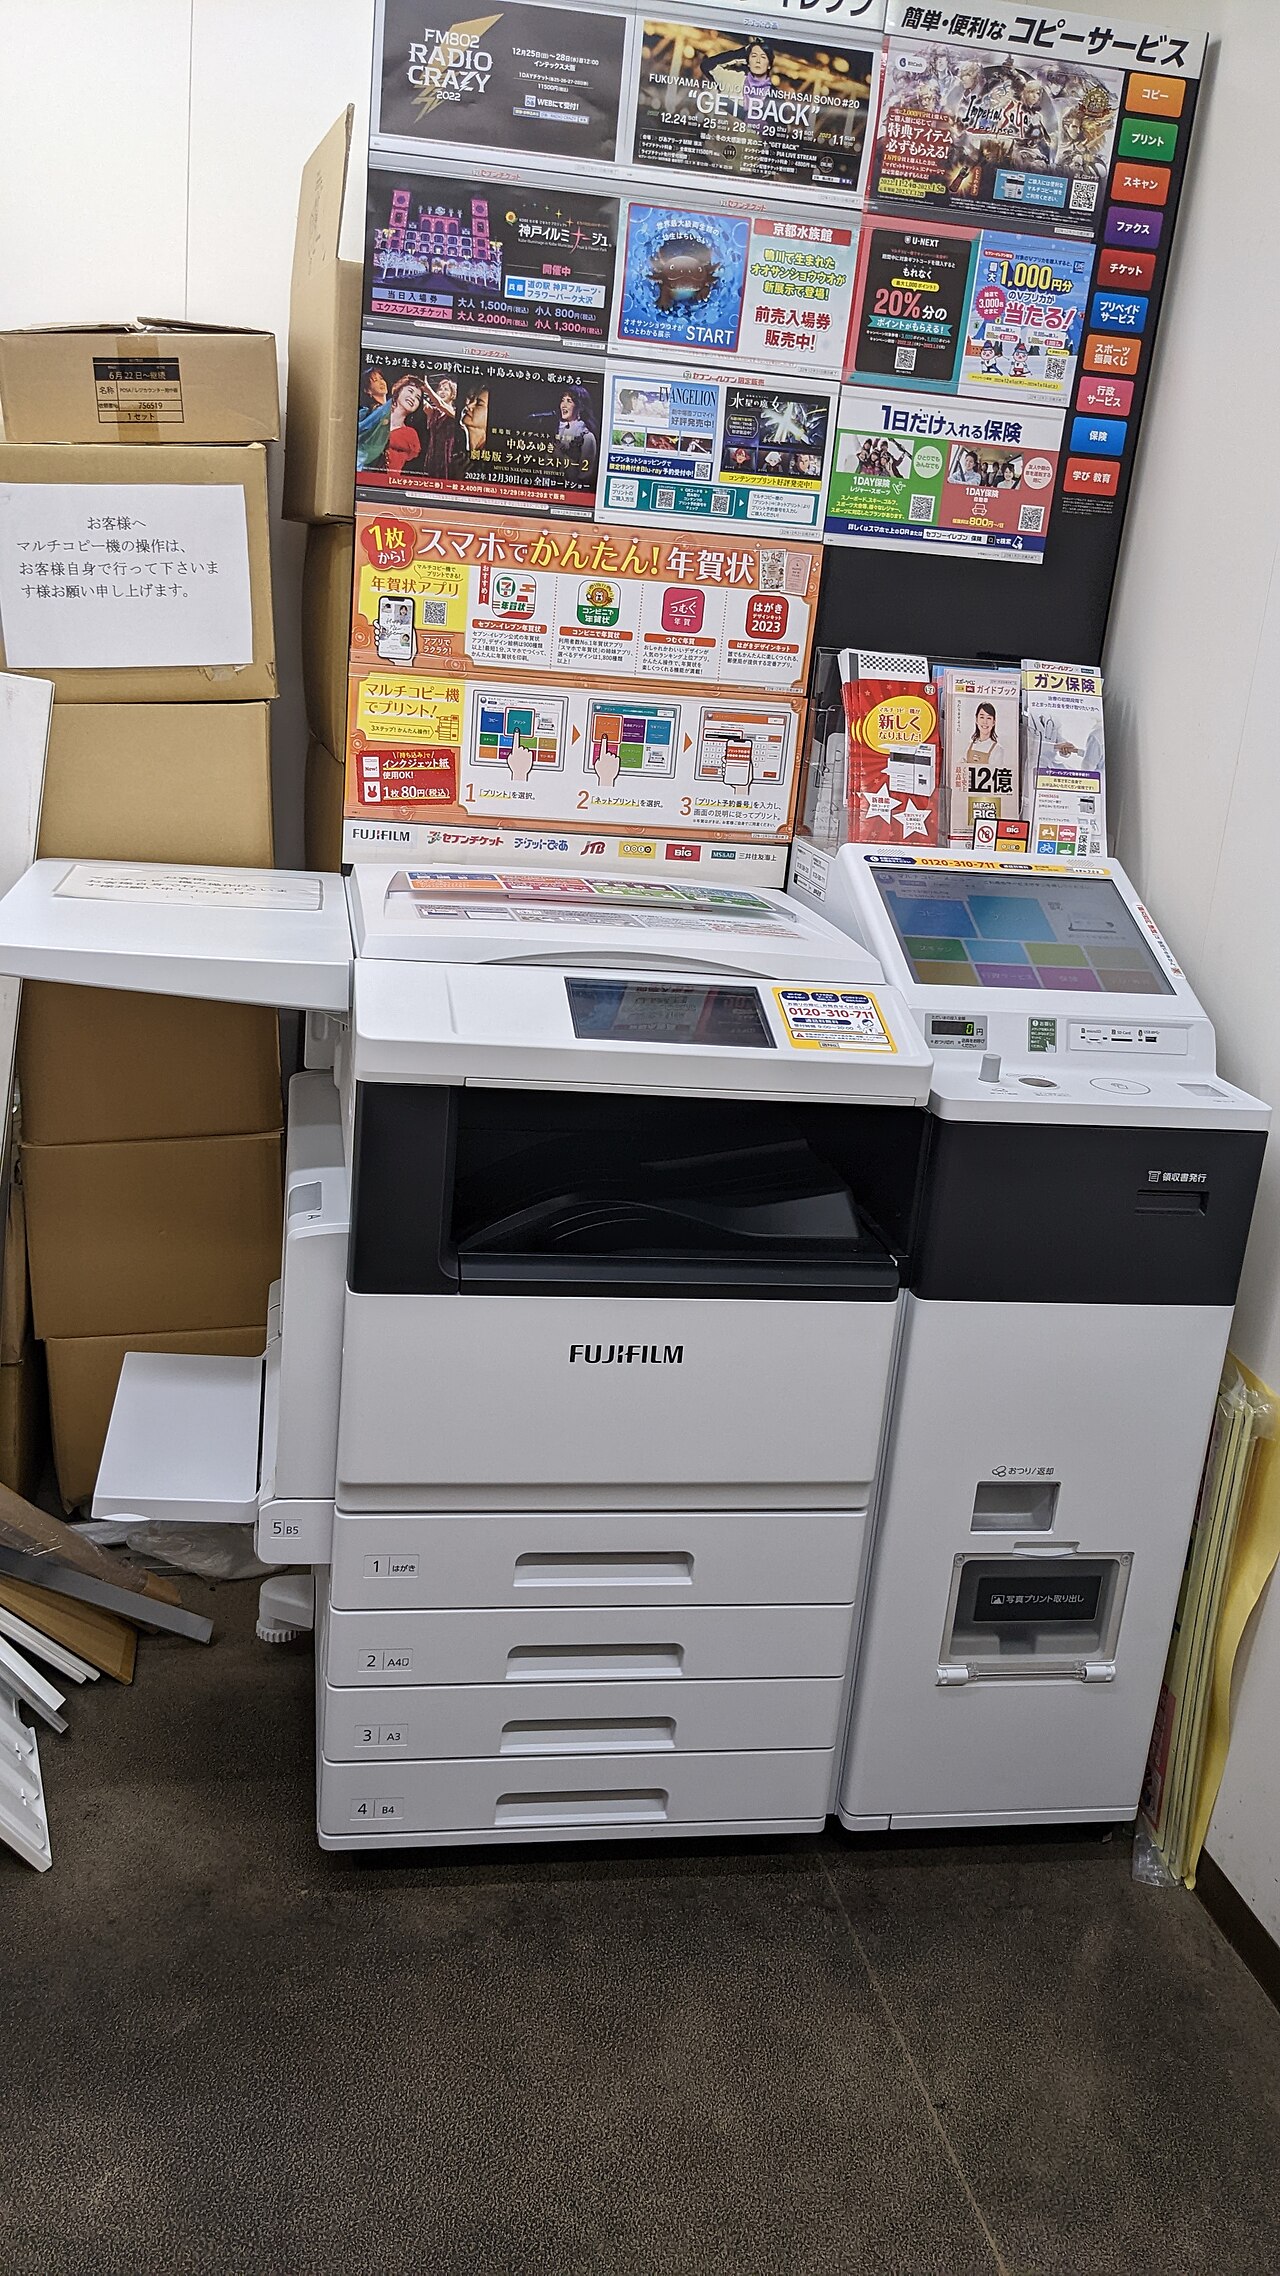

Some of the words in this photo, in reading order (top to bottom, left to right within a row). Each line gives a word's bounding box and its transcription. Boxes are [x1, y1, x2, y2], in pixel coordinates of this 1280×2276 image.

[425, 28, 479, 48] FM802
[1008, 15, 1191, 67] コピーサービス
[409, 43, 493, 72] RADIO
[407, 66, 491, 93] CRAZY
[437, 91, 461, 101] 2022
[650, 73, 699, 88] FUKUYAMA
[702, 78, 726, 91] FUYU
[729, 81, 741, 92] NO
[744, 85, 812, 102] DAIKANSHASAI
[814, 95, 841, 107] SONO
[842, 98, 860, 109] #20
[1142, 89, 1168, 100] コピー
[661, 112, 686, 125] 12.24
[703, 118, 716, 128] 25
[733, 122, 746, 132] 28
[762, 126, 775, 136] 29
[792, 130, 802, 140] 31
[833, 136, 843, 145] 1.1
[888, 123, 953, 143] 特典アイテム
[1132, 134, 1164, 146] プリント
[1124, 177, 1158, 189] スキャン
[773, 223, 832, 242] 京都水族館
[1116, 222, 1150, 234] ファクス
[518, 223, 608, 249] 神戸イルミナージュ
[764, 250, 836, 270] 鴨川で生まれた
[751, 264, 846, 285] オオサンショウウオが
[903, 268, 932, 279] もれなく
[988, 262, 998, 283] 最大
[1000, 260, 1074, 292] 1,000円分
[1110, 263, 1142, 276] チケット
[527, 280, 550, 290] 道の駅
[528, 291, 593, 304] フラワーパーク大沢
[874, 288, 947, 320] 20%分の
[1008, 291, 1055, 304] のVプリカが
[458, 298, 475, 309] 大人
[536, 307, 551, 316] 小人
[1100, 302, 1140, 315] プリペイド
[376, 303, 448, 318] エクスプレスチケット
[457, 311, 475, 321] 大人
[535, 320, 551, 330] 小人
[754, 306, 831, 330] 前売入場券
[1004, 301, 1076, 331] 当たる!
[1101, 312, 1135, 325] サービス
[624, 318, 684, 331] オオサンショウウオが
[877, 319, 944, 334] ポイントがもらえる!
[624, 328, 671, 339] もっとわかる展示
[685, 326, 734, 345] START
[765, 329, 816, 350] 販売中!
[1096, 344, 1131, 355] スポーツ
[99, 386, 114, 394] 名称
[659, 386, 716, 407] EVANGELION
[1097, 385, 1115, 396] 行政
[728, 392, 780, 412] 水星の魔女
[1087, 394, 1121, 407] サービス
[881, 404, 1023, 444] 1日だけ入れる保険
[1090, 430, 1107, 442] 保険
[507, 439, 555, 453] 中島みゆき
[470, 451, 502, 463] 劇場版
[610, 456, 671, 467] セブンネットショッピングで
[917, 454, 940, 463] ひとりでも
[916, 461, 939, 470] みんなでも
[465, 472, 486, 482] 2022年
[534, 477, 590, 489] 全国ロードショー
[1073, 471, 1090, 481] 学び
[1093, 473, 1111, 483] 教育
[88, 516, 146, 530] お客様へ
[368, 524, 407, 551] 1枚
[17, 539, 186, 553] マルチコピー機の操作は、
[378, 550, 405, 563] から!
[19, 562, 219, 576] お客様自身で行って下さいま
[416, 564, 456, 573] マルチコピー機で
[21, 584, 192, 598] す様お願い申し上げます。
[371, 576, 459, 596] 年賀状アプリ
[501, 601, 526, 611] 年賀状
[583, 608, 614, 616] コンビニで
[670, 601, 697, 614] つむぐ
[753, 601, 783, 613] はがき
[585, 615, 610, 624] 年賀状
[674, 618, 690, 626] 年賀
[752, 613, 781, 621] デザインキット
[751, 620, 781, 632] 2023
[573, 630, 620, 639] コンビニで年賀状
[665, 636, 695, 645] つむぐ年賀
[423, 638, 450, 647] アプリで
[737, 642, 790, 652] はがきデザインキット
[1035, 674, 1096, 693] ガン保険
[365, 683, 459, 703] マルチコピー機
[977, 686, 1017, 695] ガイドブック
[365, 701, 438, 718] でプリント!
[879, 714, 921, 731] 新しく
[383, 757, 450, 769] インクジェット紙
[383, 771, 413, 779] 使用OK!
[969, 767, 1012, 793] 12億
[384, 786, 399, 797] 1枚
[465, 783, 476, 802] 1
[479, 788, 535, 800] 「プリント」を選択。
[576, 790, 589, 810] 2
[591, 796, 664, 809] 「ネットプリント」を選択。
[680, 797, 691, 816] 3
[353, 828, 410, 842] FUJIFILM
[443, 834, 504, 846] セブンチケット
[580, 841, 606, 856] JTB
[921, 858, 995, 869] 0120-310-711
[789, 1008, 874, 1019] 0120-310-711
[966, 1024, 973, 1034] 0
[570, 1345, 683, 1363] FUJIFILM
[1008, 1467, 1054, 1475] おつり/返却
[273, 1522, 282, 1534] 5
[287, 1526, 298, 1535] B5
[374, 1561, 380, 1572] 1
[393, 1564, 415, 1572] はがき
[1006, 1594, 1084, 1604] 写真プリント取り出し
[367, 1655, 376, 1667] 2
[388, 1658, 401, 1667] A4
[363, 1729, 372, 1742] 3
[387, 1732, 401, 1740] A3
[358, 1803, 367, 1814] 4
[382, 1806, 394, 1814] B4
